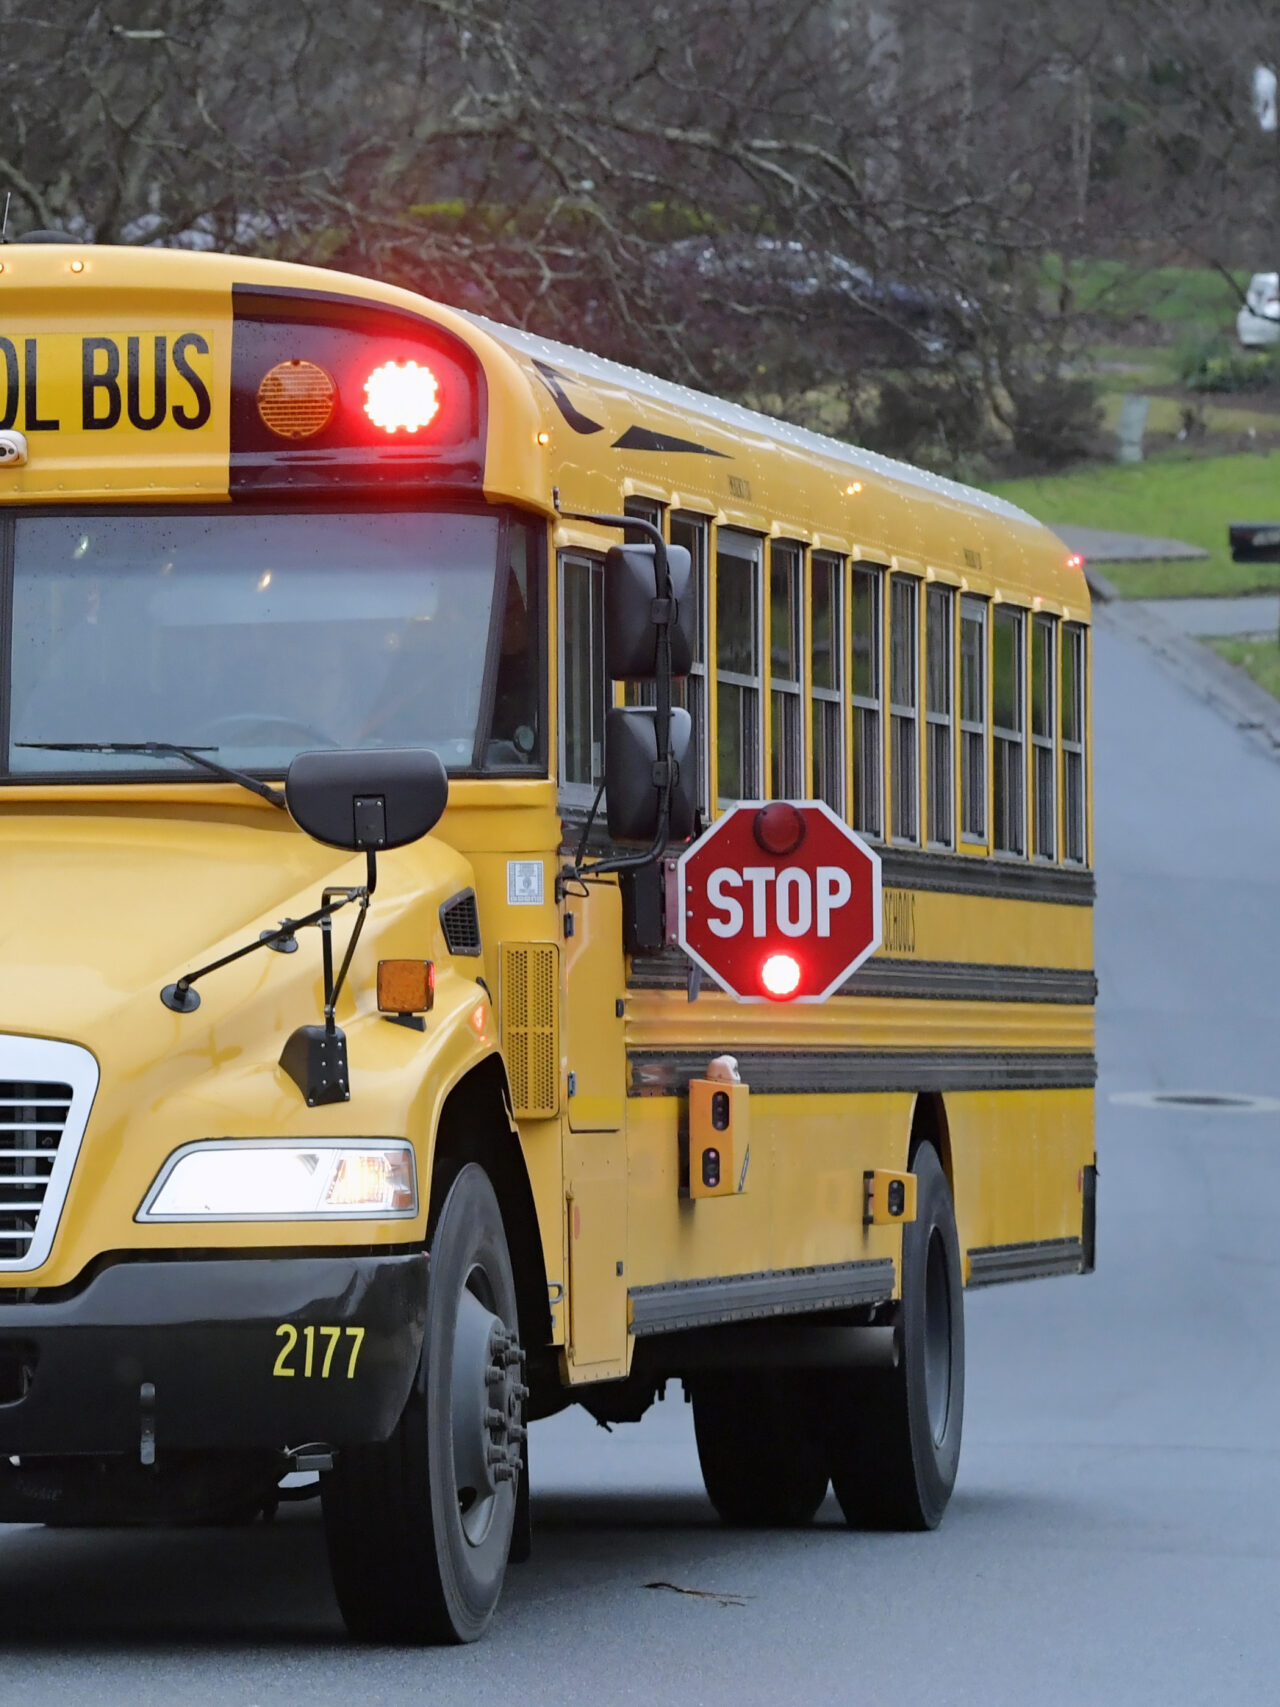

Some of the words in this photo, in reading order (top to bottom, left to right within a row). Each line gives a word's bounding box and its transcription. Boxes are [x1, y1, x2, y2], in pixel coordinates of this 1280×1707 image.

[82, 333, 211, 430] BUS
[706, 866, 852, 938] STOP
[273, 1323, 365, 1379] 2177
